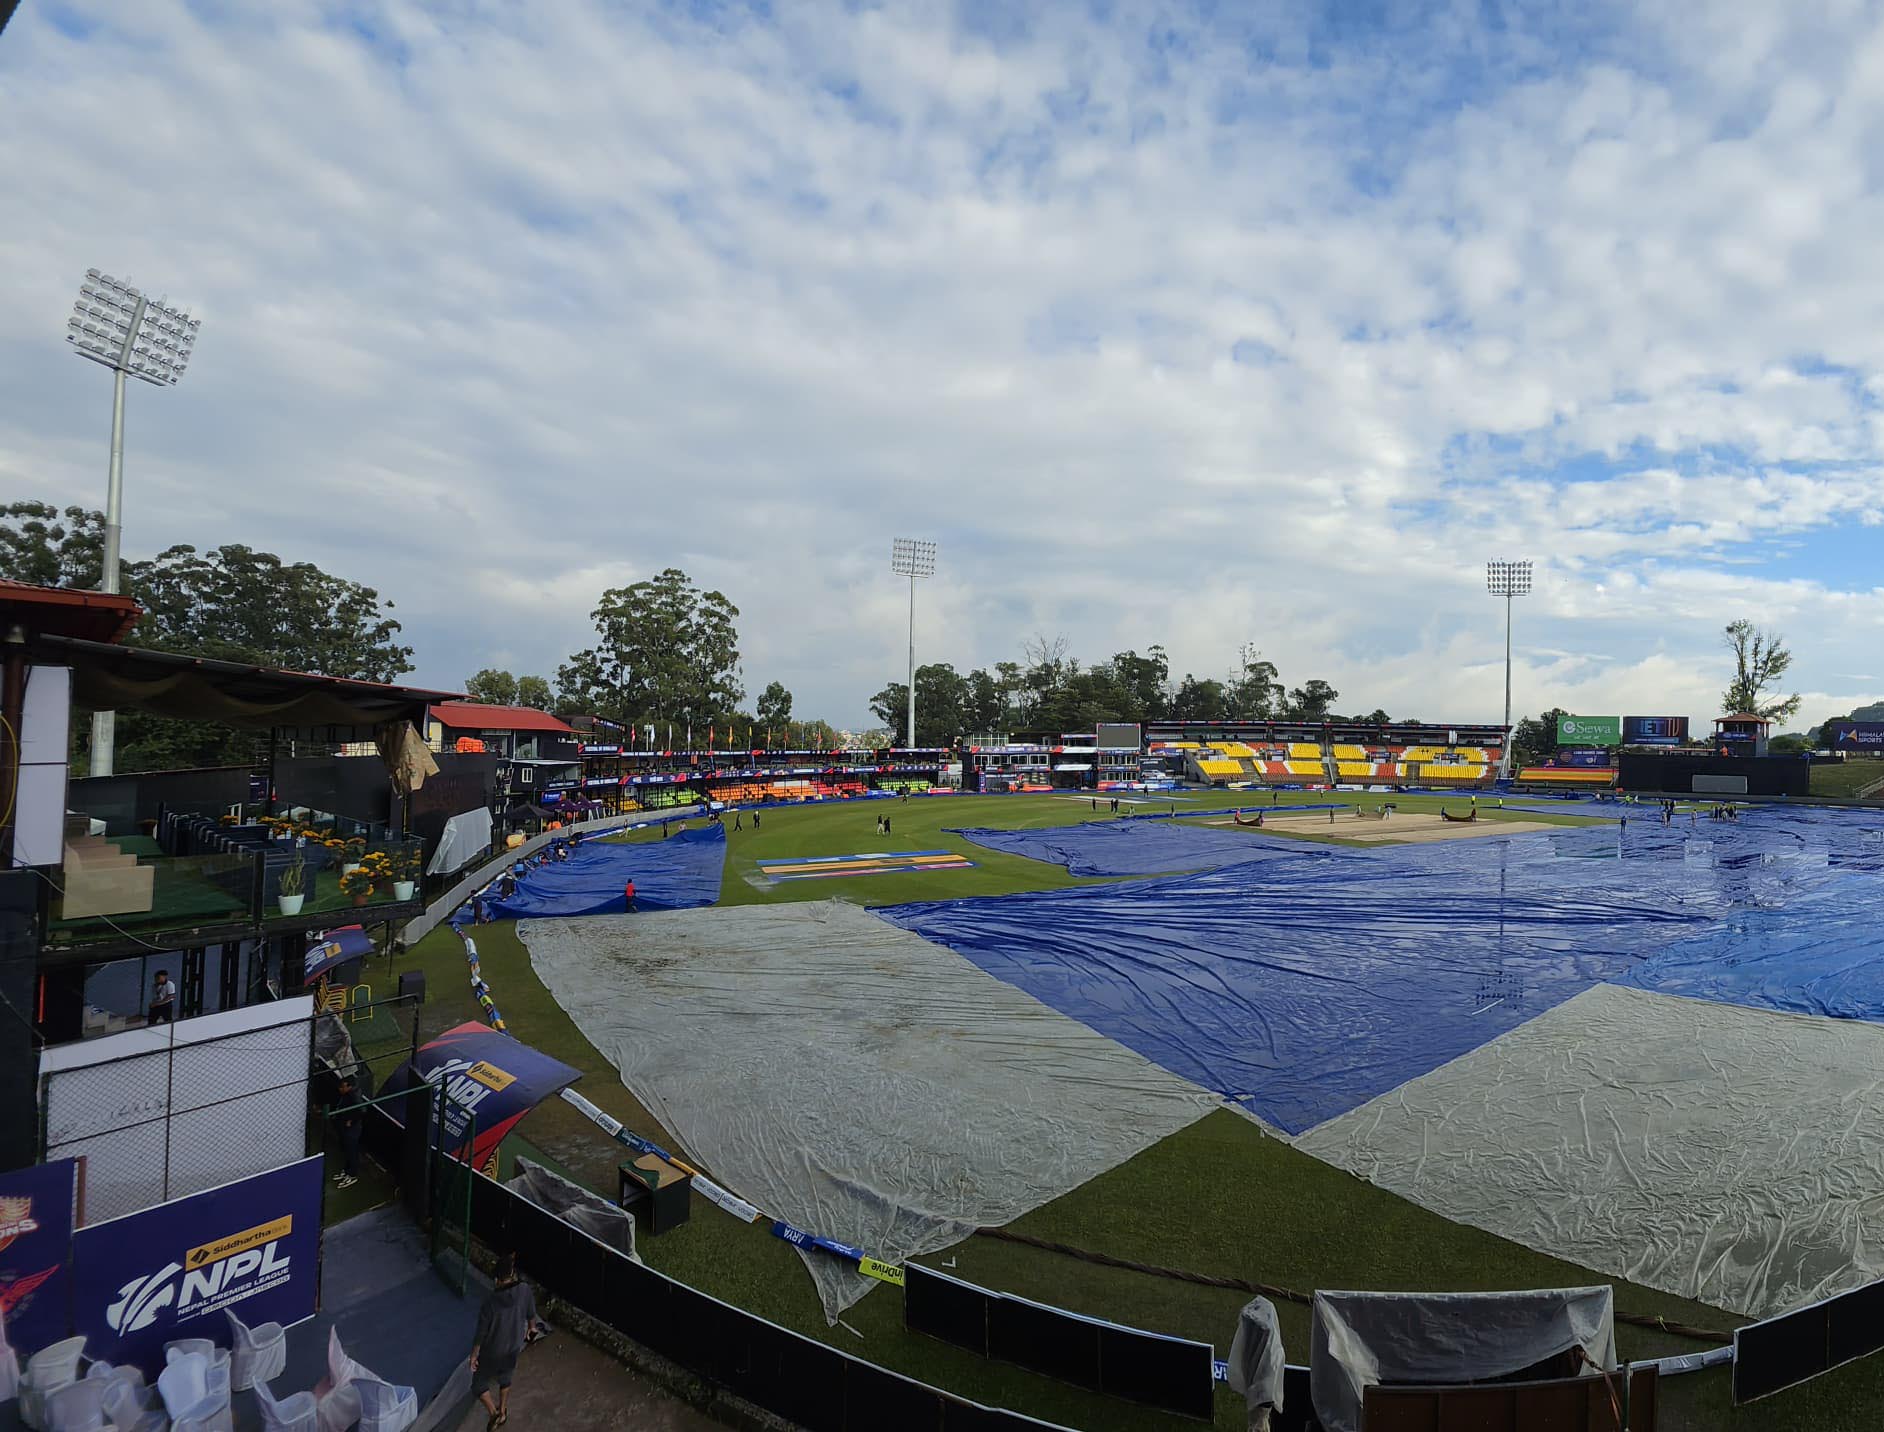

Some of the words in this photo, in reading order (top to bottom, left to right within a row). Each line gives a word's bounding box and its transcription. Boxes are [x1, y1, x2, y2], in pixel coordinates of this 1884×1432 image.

[1563, 721, 1612, 734] eSewa
[212, 1229, 272, 1255] Siddhartha
[177, 1240, 291, 1309] NPL
[178, 1300, 210, 1316] NEPAL
[210, 1282, 253, 1303] PREMIER
[253, 1267, 290, 1286] LEAGUE
